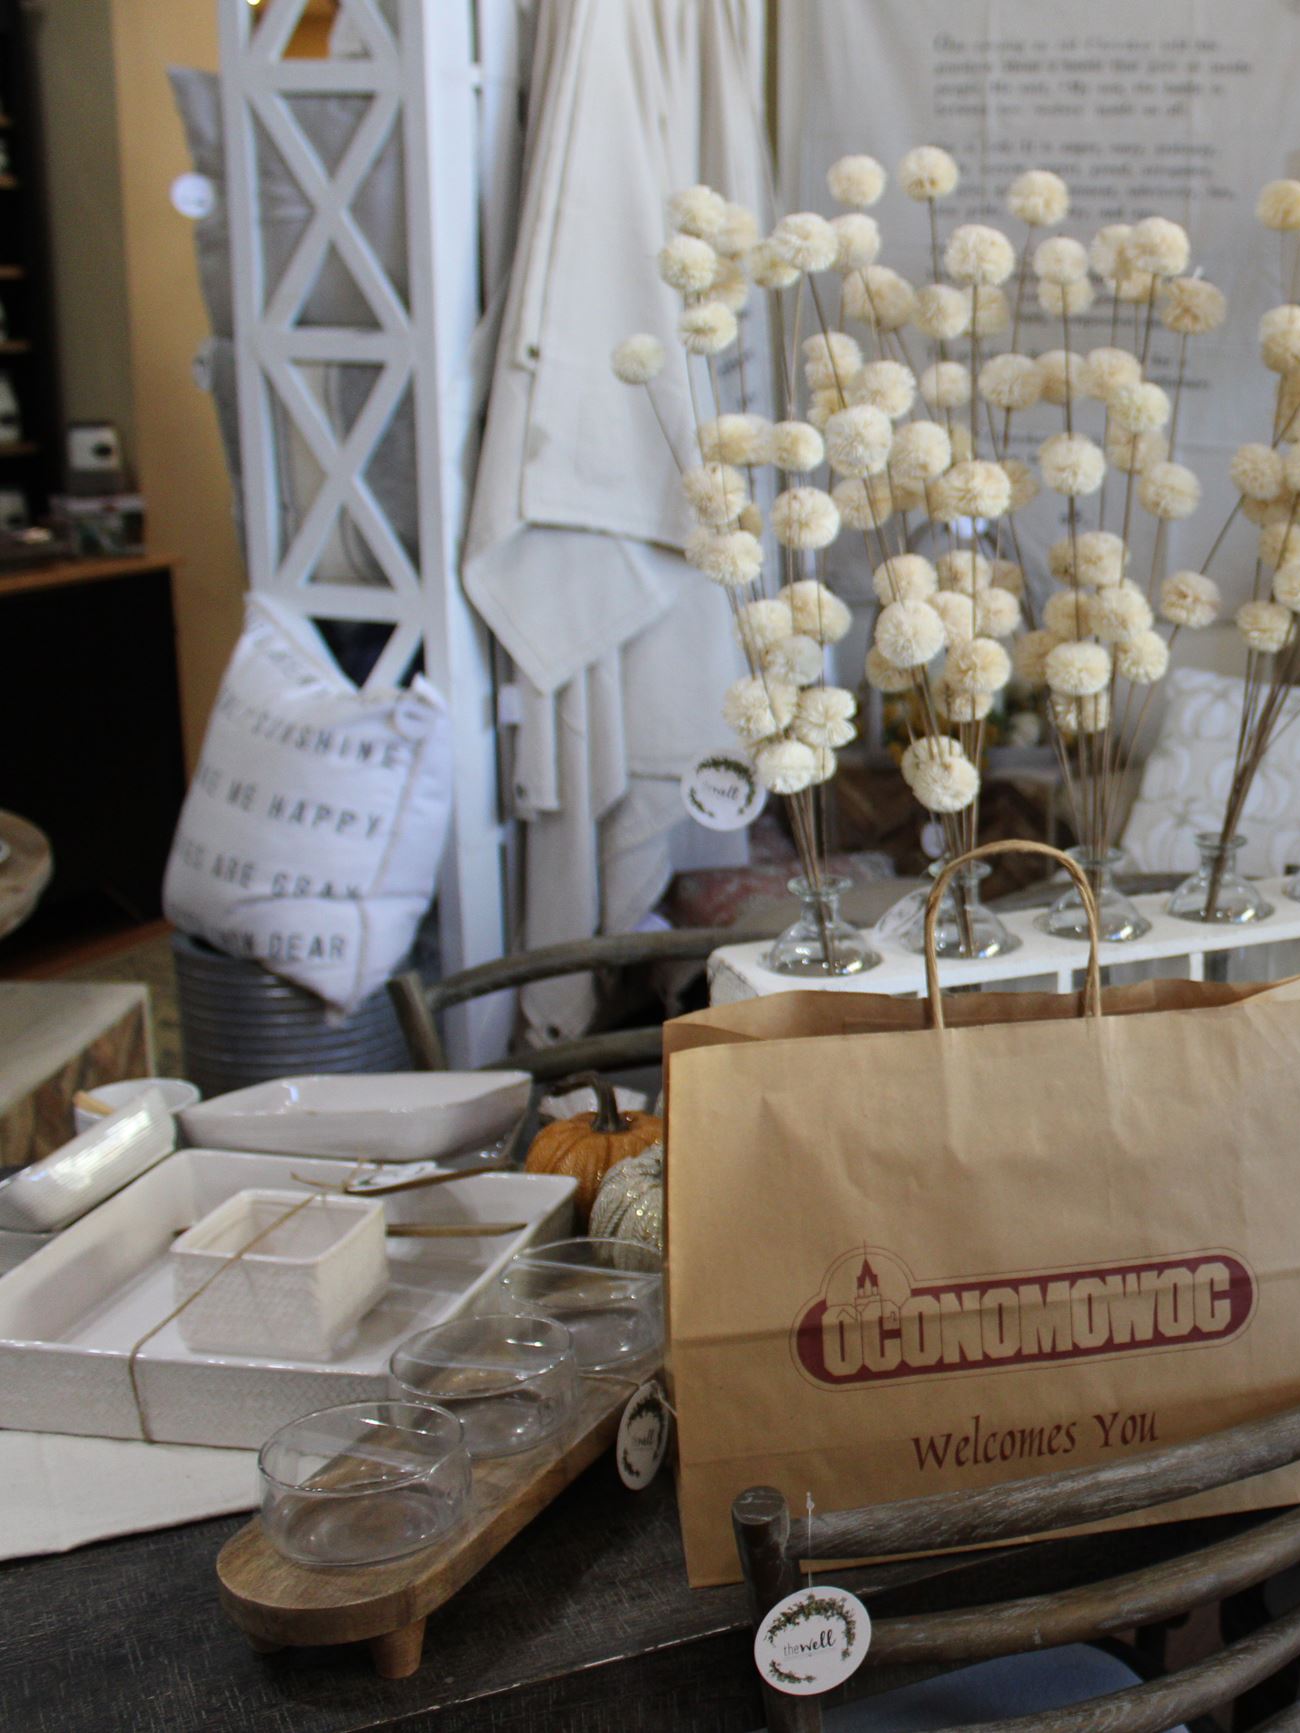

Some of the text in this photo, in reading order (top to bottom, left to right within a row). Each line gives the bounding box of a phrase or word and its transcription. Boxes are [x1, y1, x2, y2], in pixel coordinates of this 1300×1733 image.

[268, 794, 384, 841] HAPPY
[210, 853, 256, 888] ARE
[269, 931, 346, 962] DEAR
[821, 1261, 1232, 1377] OCONOMOWOC
[911, 1410, 1159, 1471] Welcomes You
